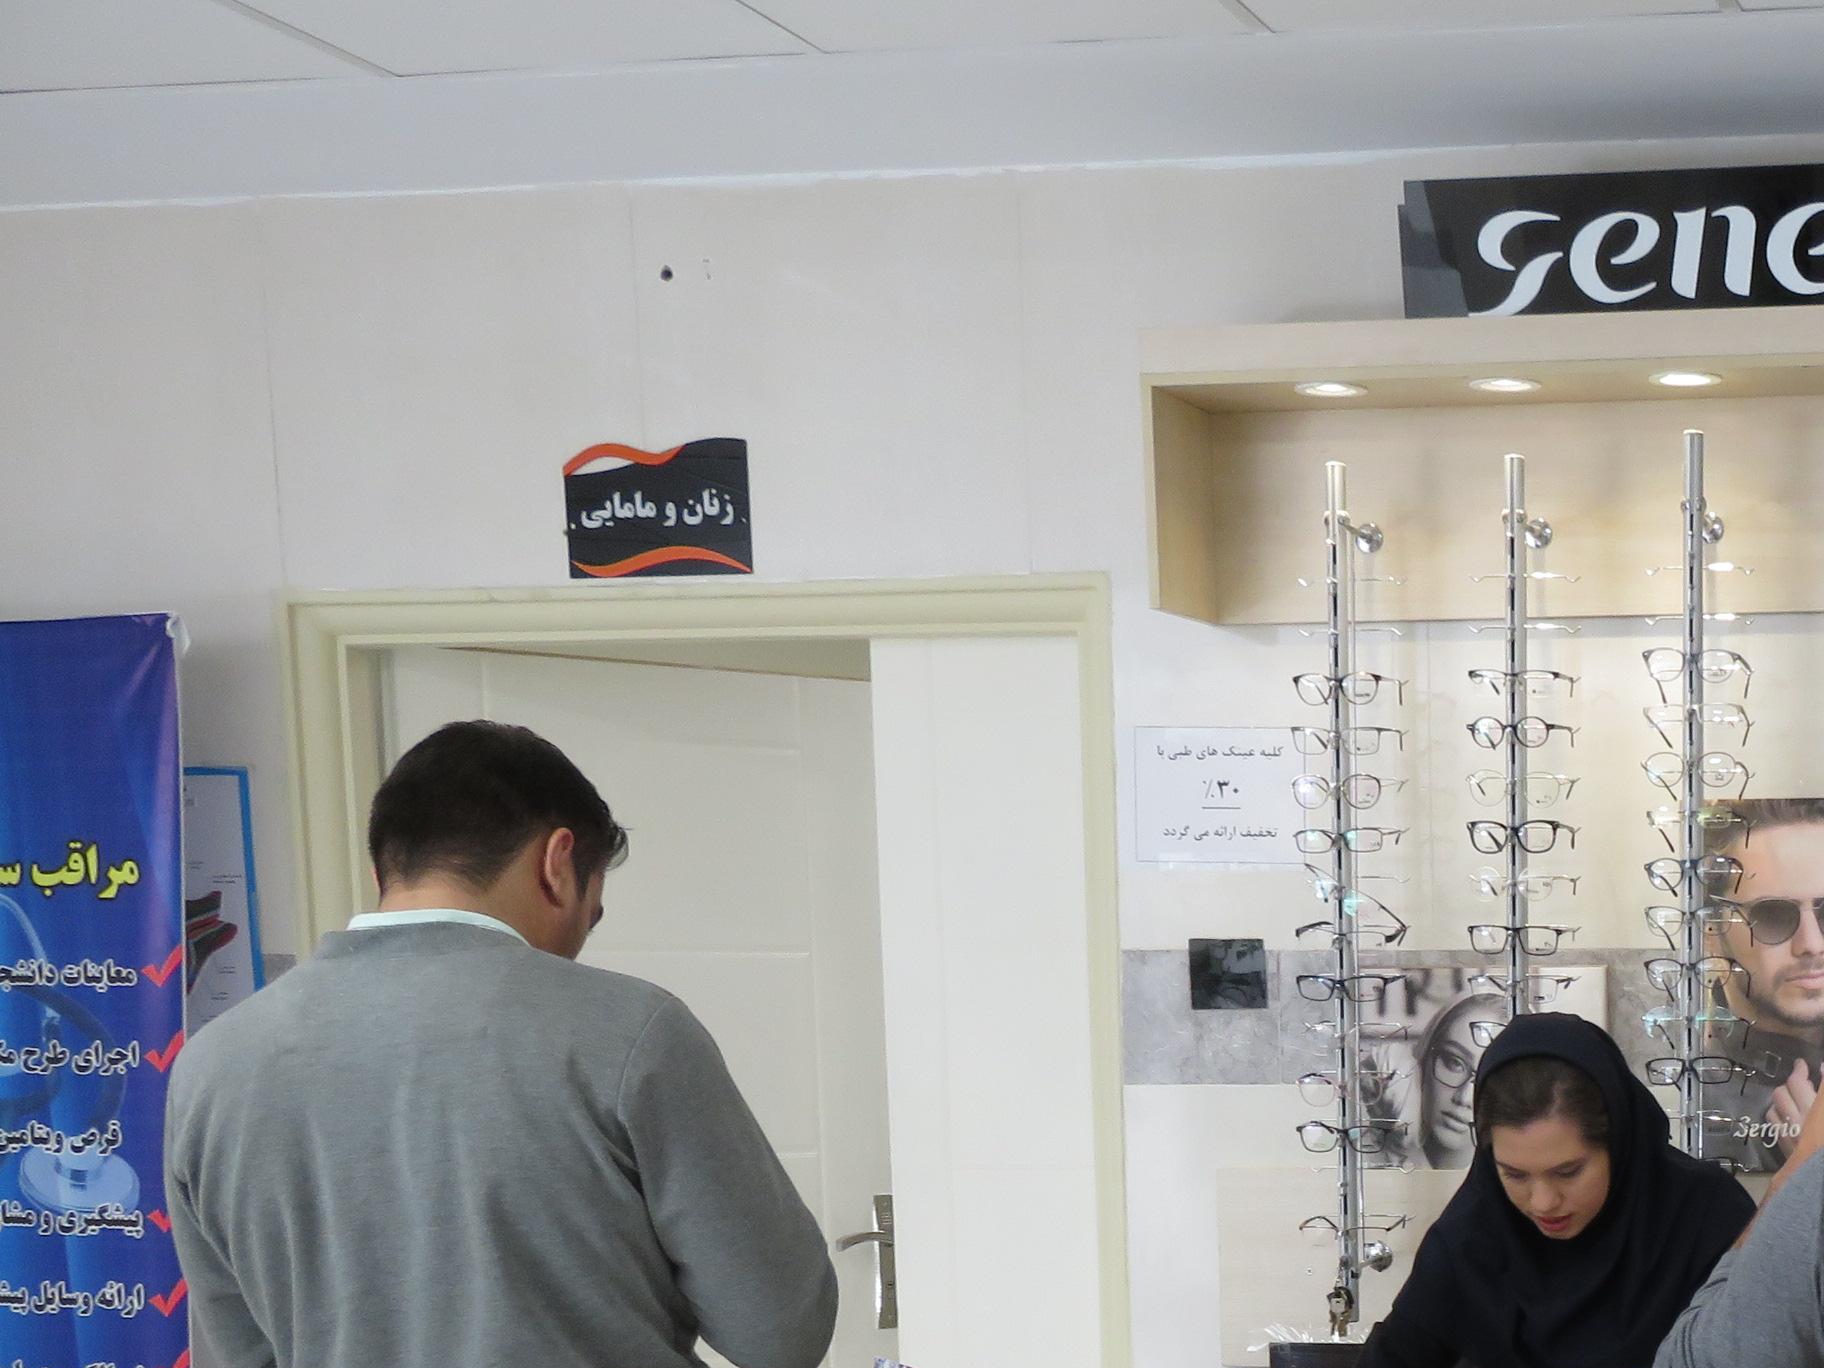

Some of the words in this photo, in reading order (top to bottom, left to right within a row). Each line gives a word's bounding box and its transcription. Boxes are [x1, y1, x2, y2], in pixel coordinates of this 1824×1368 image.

[581, 491, 657, 529] مامایی
[663, 502, 677, 526] و
[682, 488, 734, 525] زنان
[1156, 745, 1164, 758] با
[1168, 746, 1192, 760] طبی
[1196, 746, 1218, 760] های
[1222, 746, 1255, 759] عینک
[1259, 746, 1284, 760] کلیه
[1163, 826, 1190, 841] گردد
[1194, 830, 1209, 841] می
[1240, 827, 1278, 840] تخفیف
[32, 841, 140, 899] مراقب
[62, 958, 138, 993] معاینات
[20, 1040, 70, 1076] طرح
[72, 1040, 140, 1076] اجرای
[69, 1120, 122, 1155] قرص
[1733, 1115, 1802, 1149] Sergio
[39, 1210, 54, 1236] و
[56, 1203, 144, 1239] پیشگیری
[31, 1281, 93, 1316] وسایل
[97, 1281, 145, 1318] ارائه
